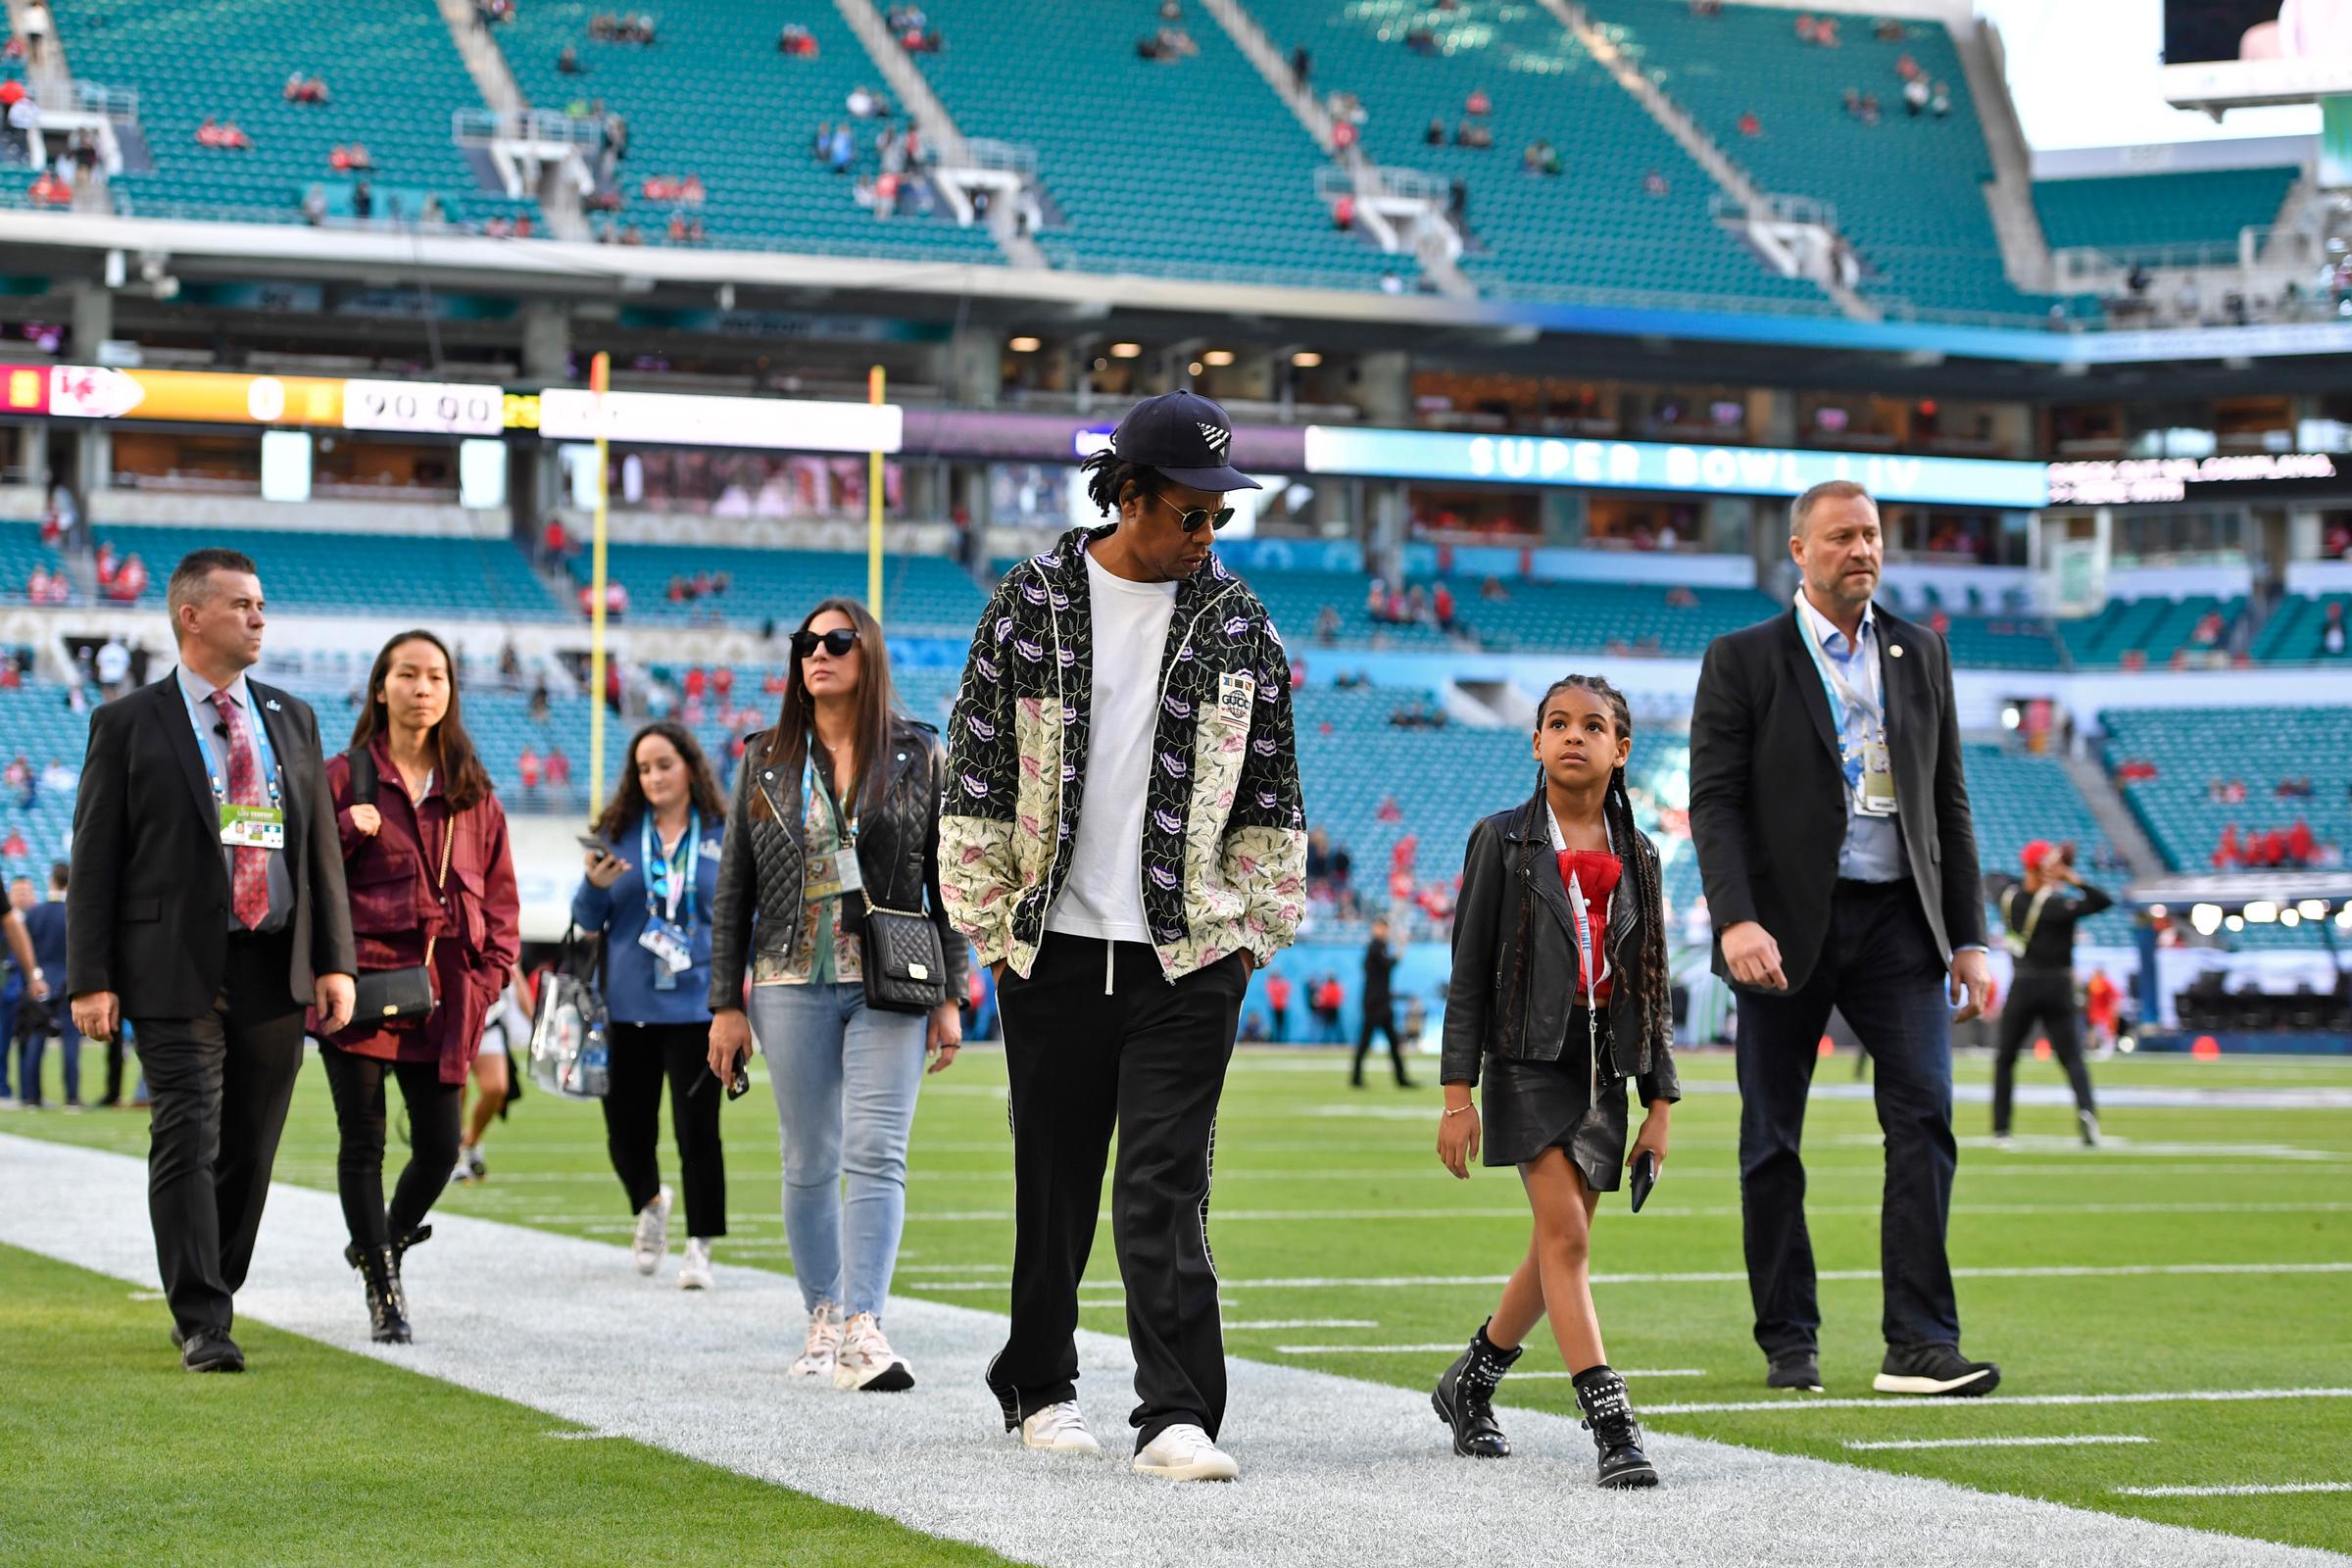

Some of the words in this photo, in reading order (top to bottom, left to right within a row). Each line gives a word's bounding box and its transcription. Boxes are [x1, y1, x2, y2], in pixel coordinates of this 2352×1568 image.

[1469, 437, 1641, 483] SUPER
[1666, 446, 1807, 491] BOWL
[1578, 915, 1592, 950] TAILGATE
